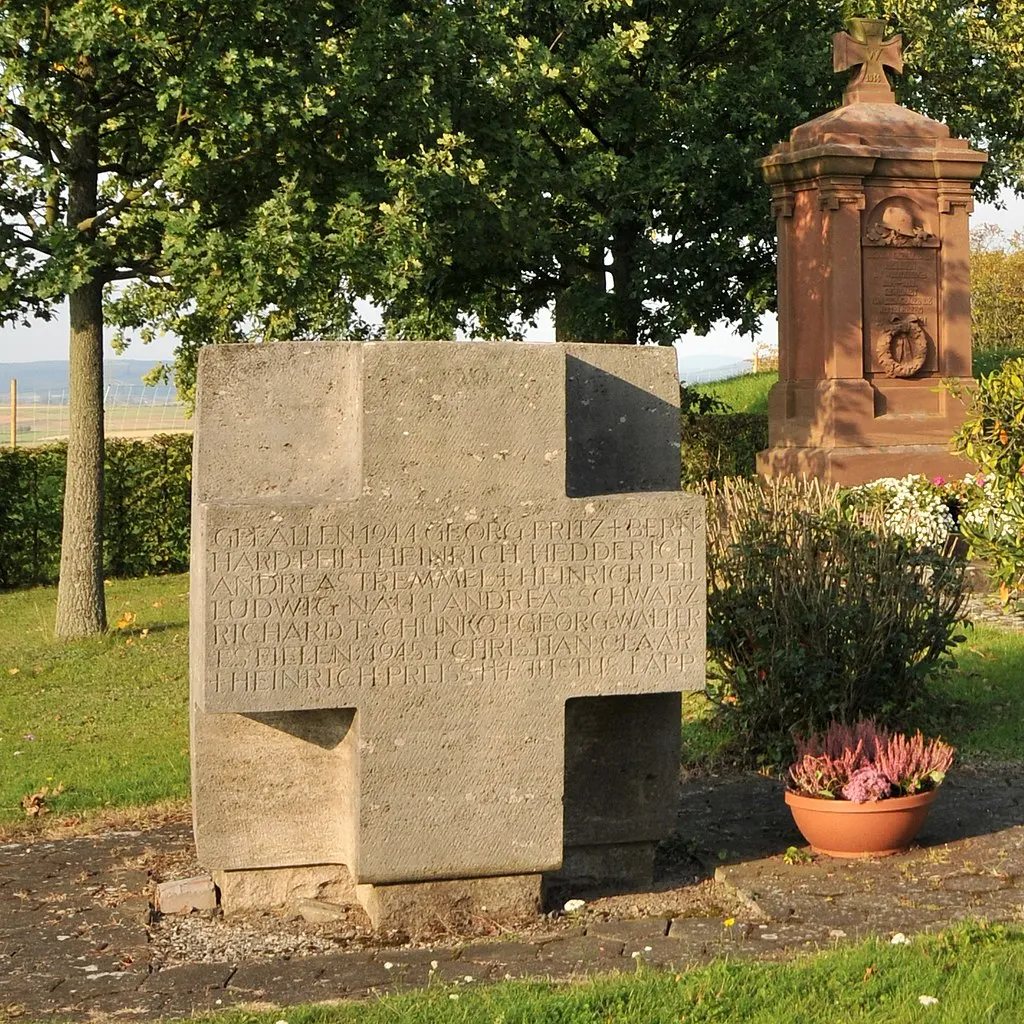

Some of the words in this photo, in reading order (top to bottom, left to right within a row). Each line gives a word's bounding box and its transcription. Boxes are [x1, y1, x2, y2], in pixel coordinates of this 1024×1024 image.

[214, 525, 356, 548] GEFALLEN
[360, 523, 418, 544] 1944
[425, 523, 526, 543] GEORG
[532, 520, 605, 540] FRITZ
[211, 550, 291, 572] HARD
[298, 548, 355, 569] PEIL
[376, 543, 519, 567] HEINRICH
[530, 539, 695, 564] HEDDERICH
[212, 573, 350, 596] ANDREAS
[354, 567, 495, 592] TREMMEL
[519, 563, 642, 586] HEINRICH
[650, 561, 702, 582] PEIL
[211, 594, 338, 621] LUDWIG
[348, 591, 414, 616] NAU
[441, 587, 572, 612] ANDREAS
[577, 583, 703, 608] SCHWARZ
[212, 621, 344, 645] RICHARD
[350, 614, 496, 640] TSCHUNKO
[518, 610, 609, 634] GEORG
[612, 607, 701, 629] WALTER
[366, 641, 424, 664] 1945
[451, 634, 593, 660] CHRISTIAN
[600, 631, 692, 653] CLAAR
[231, 667, 376, 692] HEINRICH
[523, 656, 617, 680] JUSTUS
[630, 653, 696, 675] LAPP
